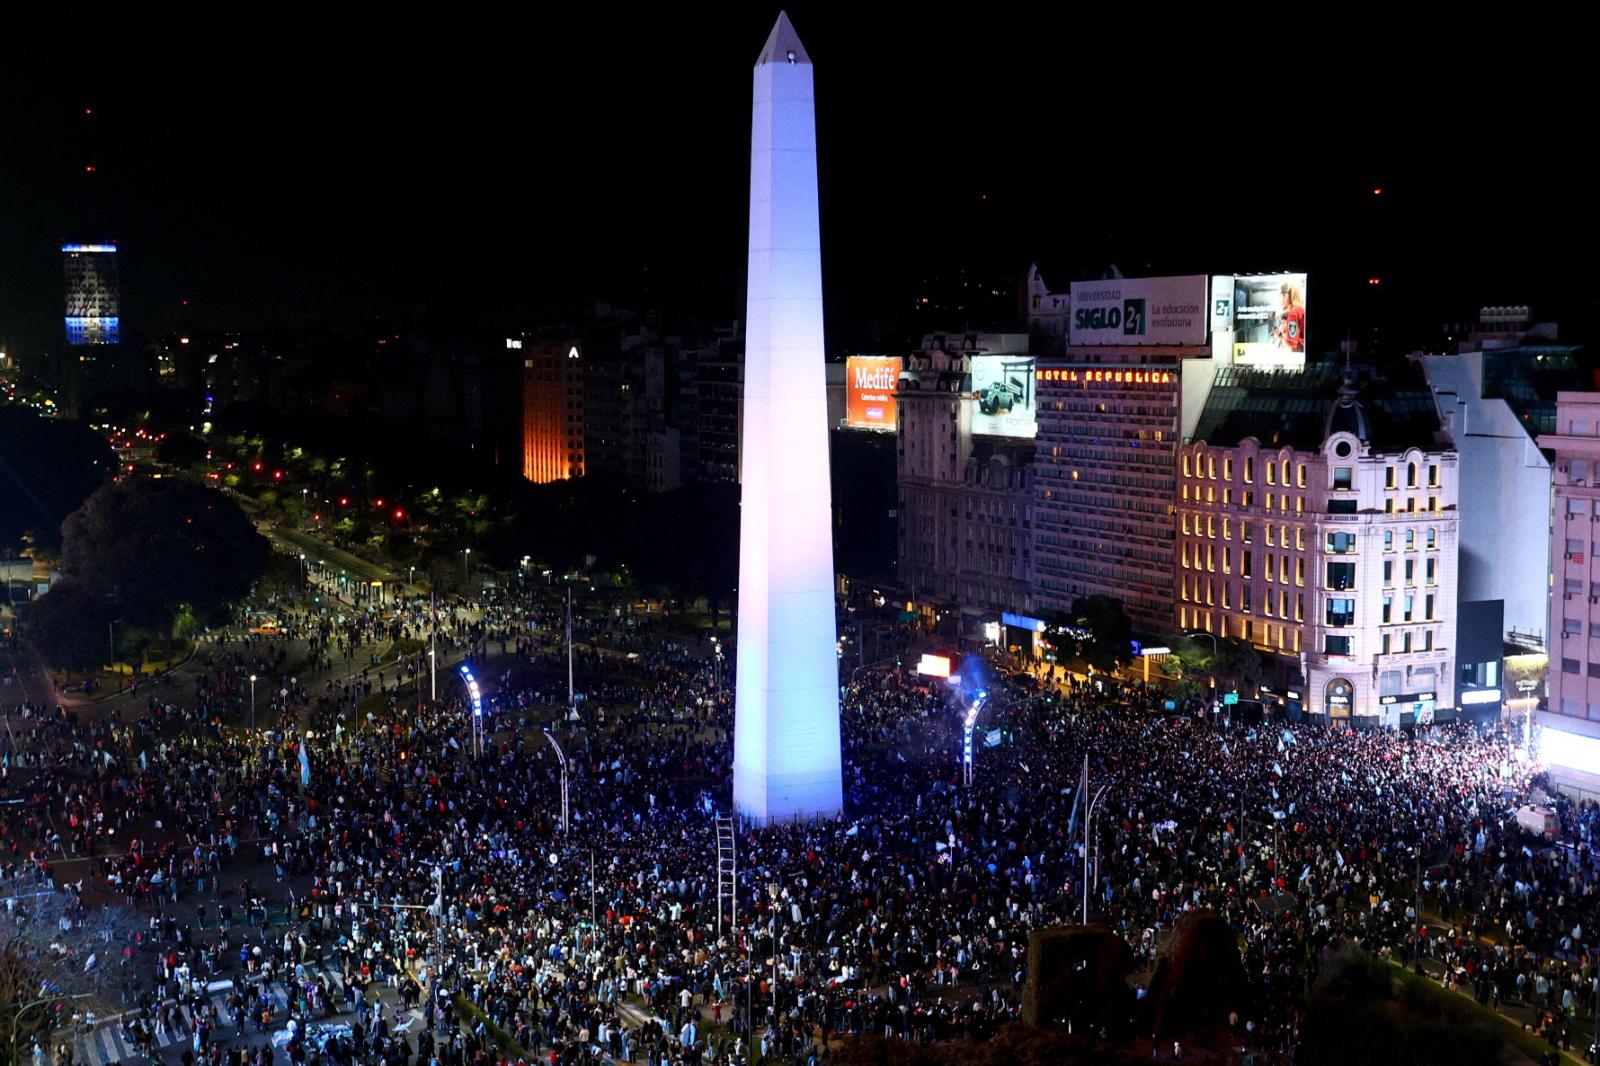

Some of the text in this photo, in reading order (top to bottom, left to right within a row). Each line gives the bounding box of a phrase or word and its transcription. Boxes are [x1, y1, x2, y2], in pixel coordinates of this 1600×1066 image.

[1077, 290, 1121, 302] UNIVERSIDAD
[1152, 303, 1199, 315] La educación
[1216, 302, 1229, 316] 21
[1074, 305, 1143, 335] SIGLO 21
[1152, 316, 1192, 328] evoluciona
[855, 367, 895, 389] Medifé
[1036, 371, 1170, 385] HOTEL REPUBLICA
